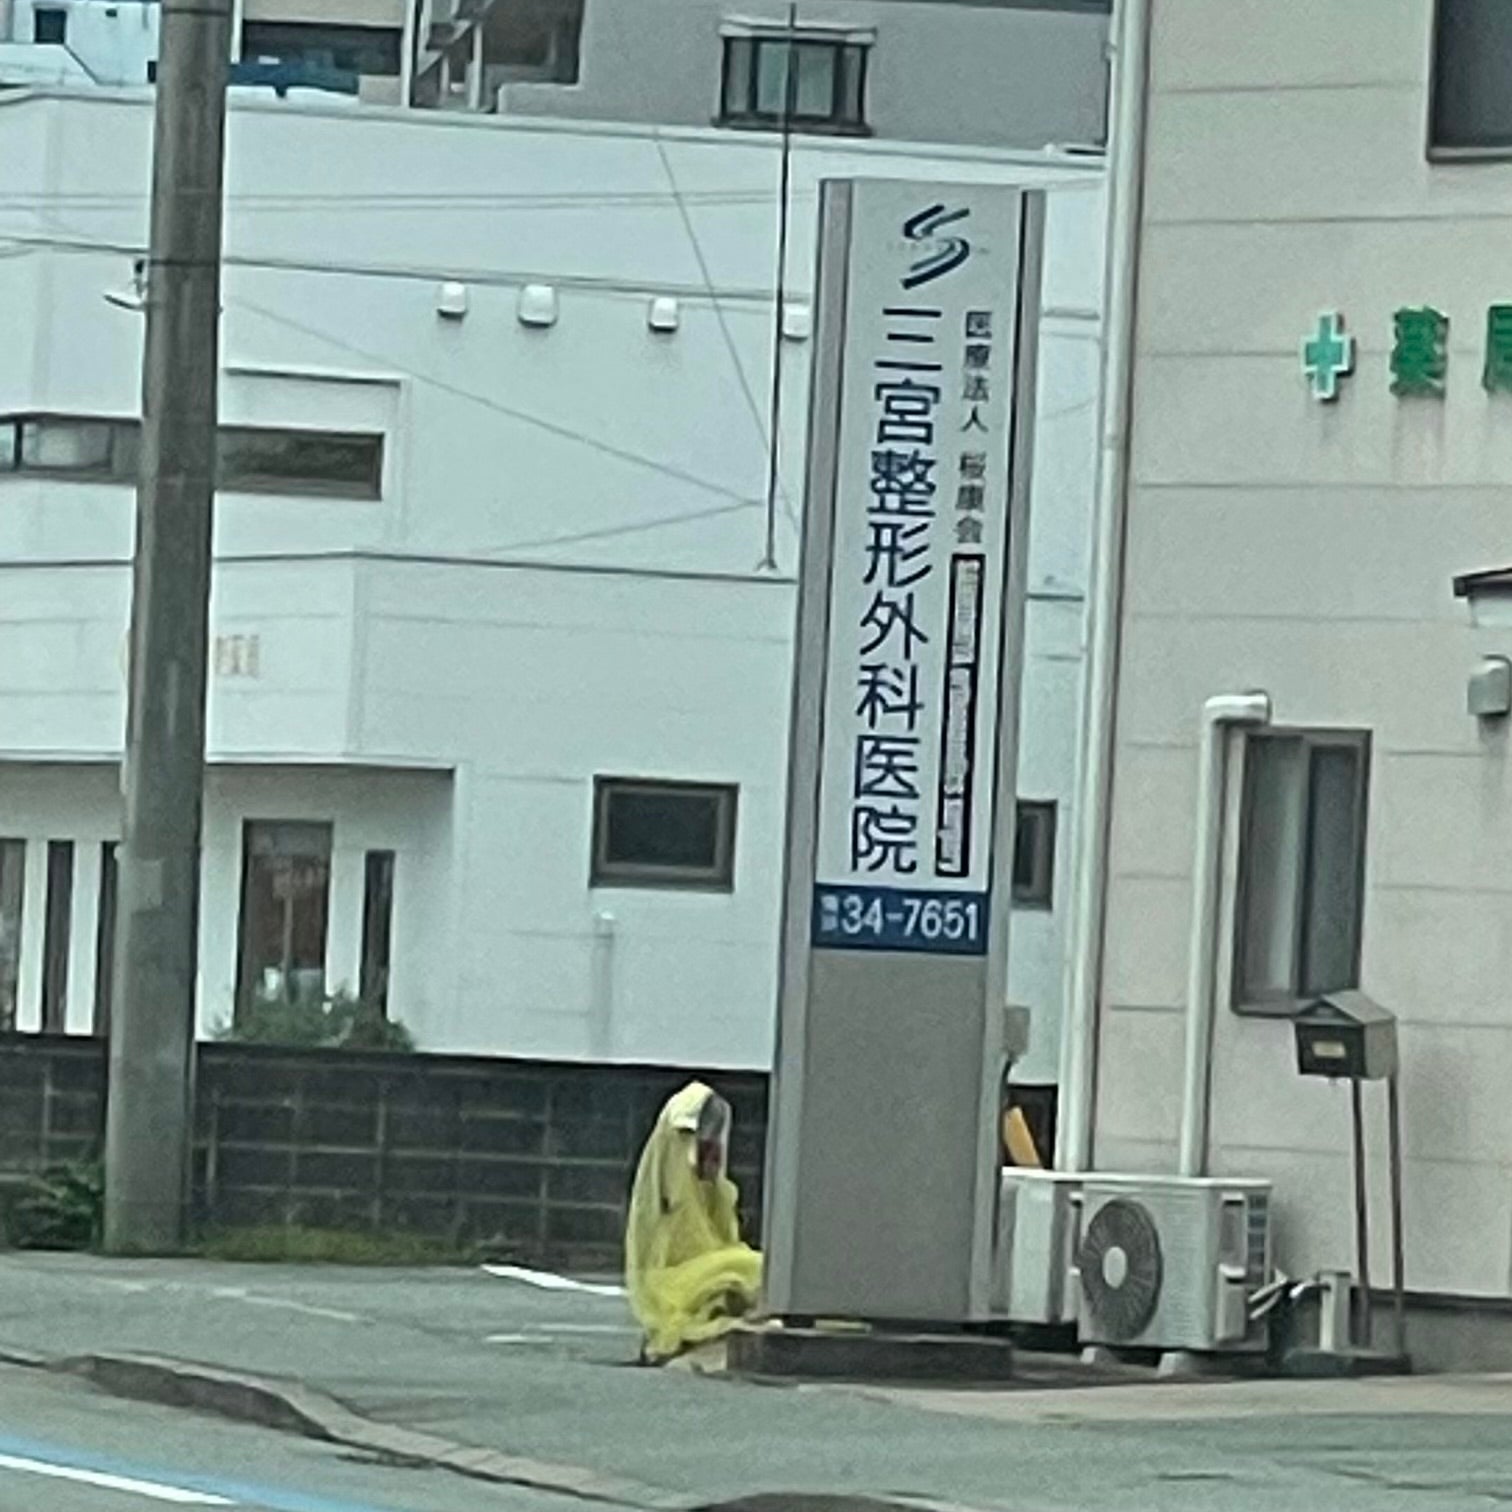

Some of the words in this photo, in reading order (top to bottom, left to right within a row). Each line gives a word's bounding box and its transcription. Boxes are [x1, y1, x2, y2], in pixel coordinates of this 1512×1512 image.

[851, 307, 943, 874] 三宮整形外科医院
